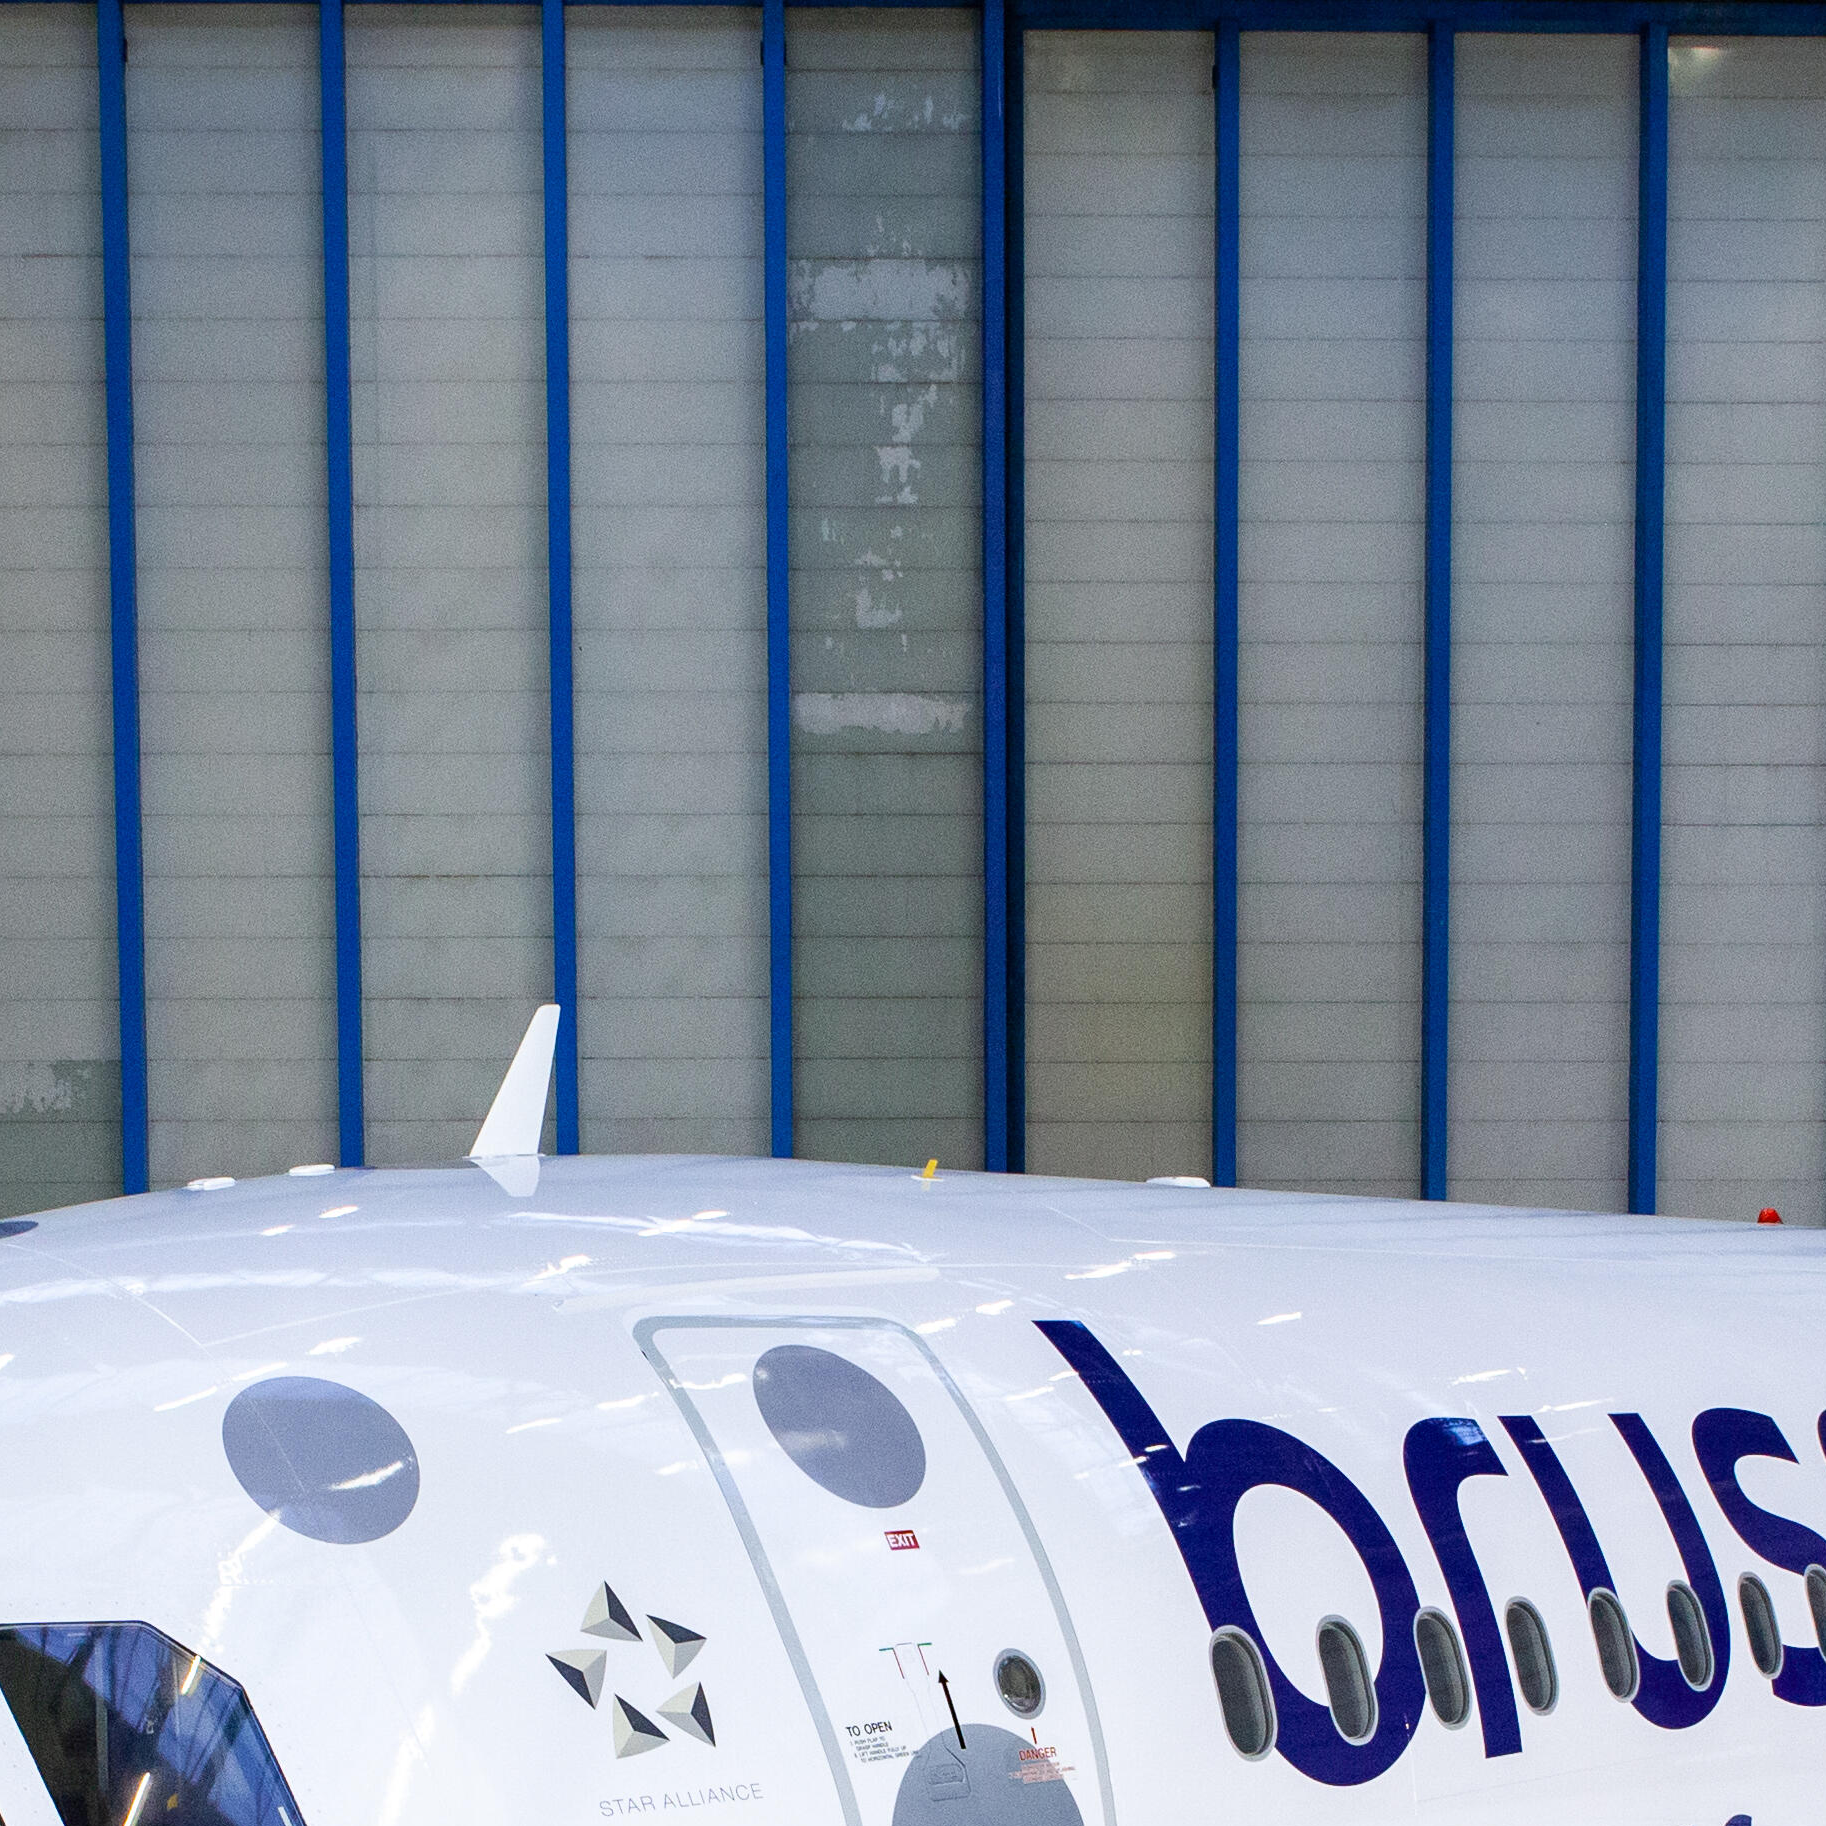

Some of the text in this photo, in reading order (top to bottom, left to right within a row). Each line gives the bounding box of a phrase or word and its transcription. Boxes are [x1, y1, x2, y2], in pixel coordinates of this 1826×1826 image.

[886, 1532, 916, 1548] EXIT
[845, 1720, 893, 1737] TO OPEN
[1019, 1746, 1057, 1761] DANGER
[599, 1782, 764, 1817] STAR ALLIANCE
